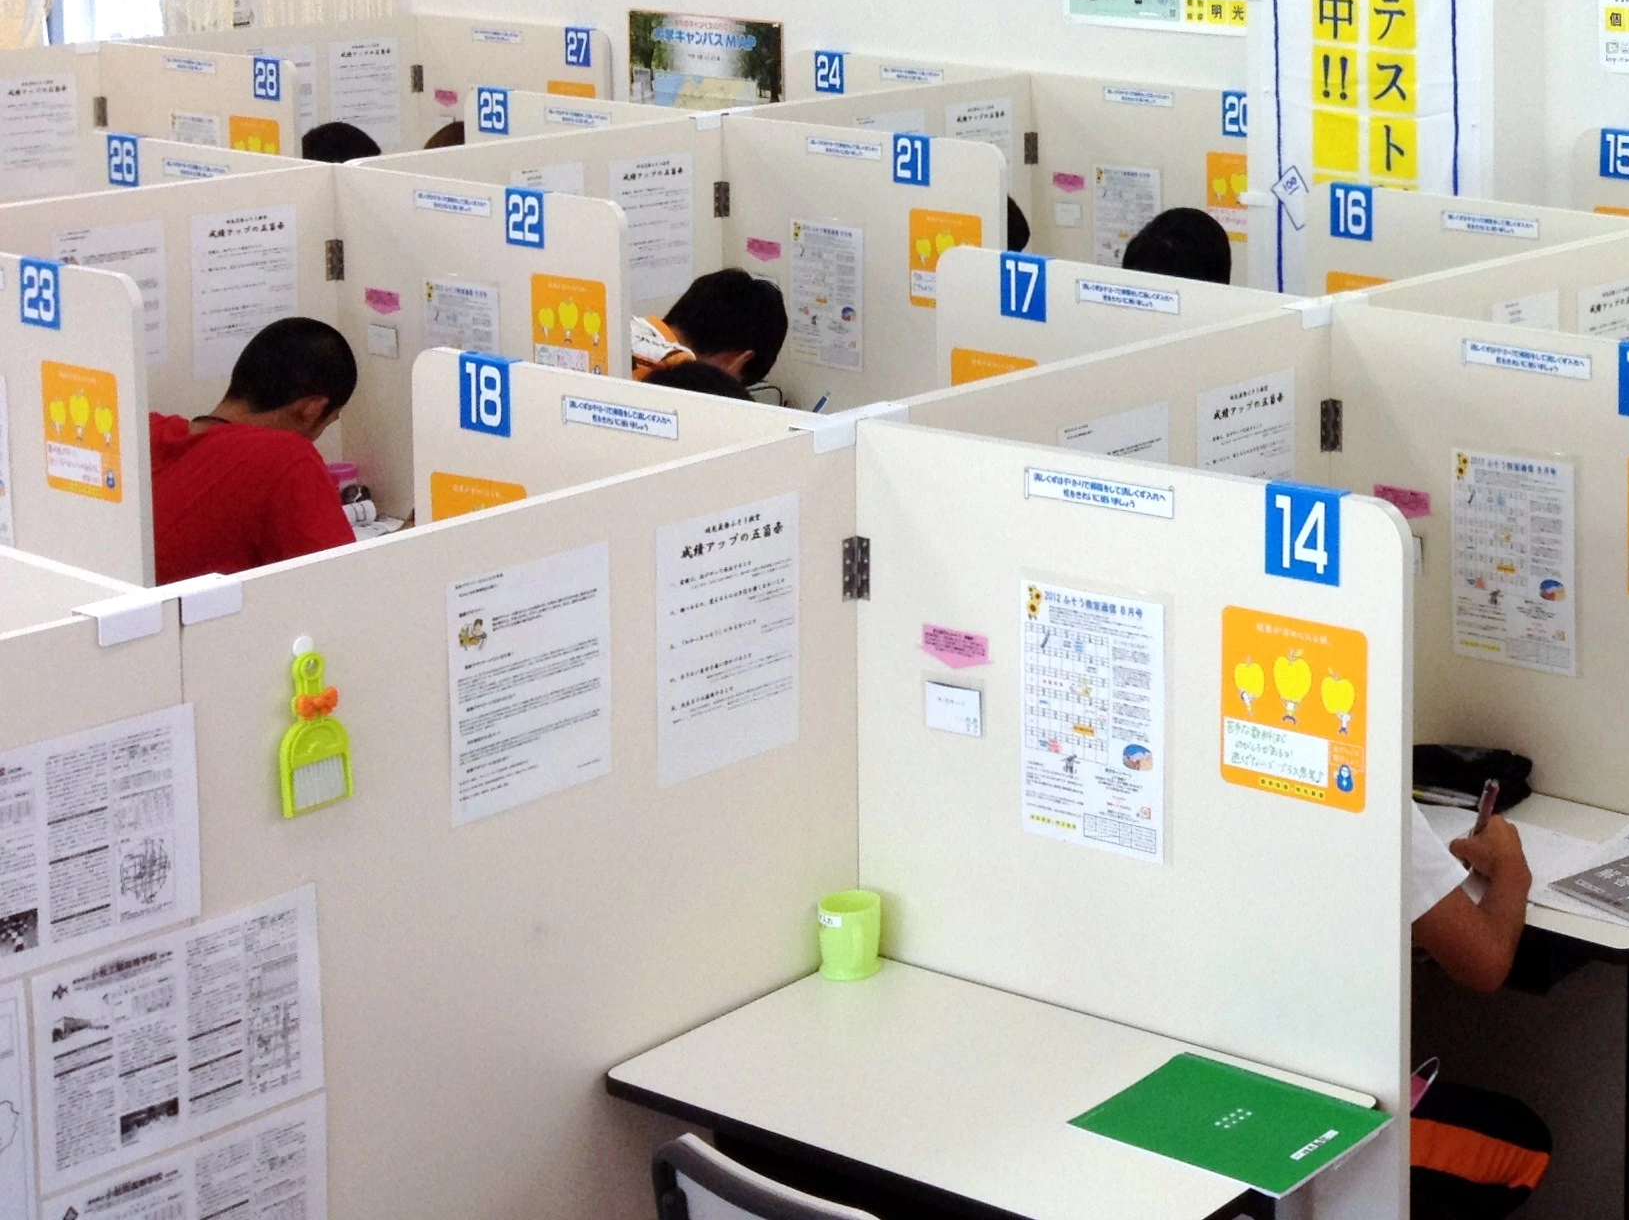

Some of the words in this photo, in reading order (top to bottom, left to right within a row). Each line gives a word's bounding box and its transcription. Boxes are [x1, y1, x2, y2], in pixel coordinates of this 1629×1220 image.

[566, 32, 588, 64] 27
[255, 61, 278, 98] 28
[816, 54, 842, 90] 24
[478, 92, 506, 131] 25
[1224, 96, 1247, 133] 20
[109, 140, 136, 184] 26
[896, 138, 924, 182] 21
[508, 194, 540, 243] 22
[1335, 189, 1366, 236] 16
[24, 266, 55, 323] 23
[1005, 261, 1040, 314] 17
[465, 362, 502, 428] 18
[1275, 493, 1328, 575] 14
